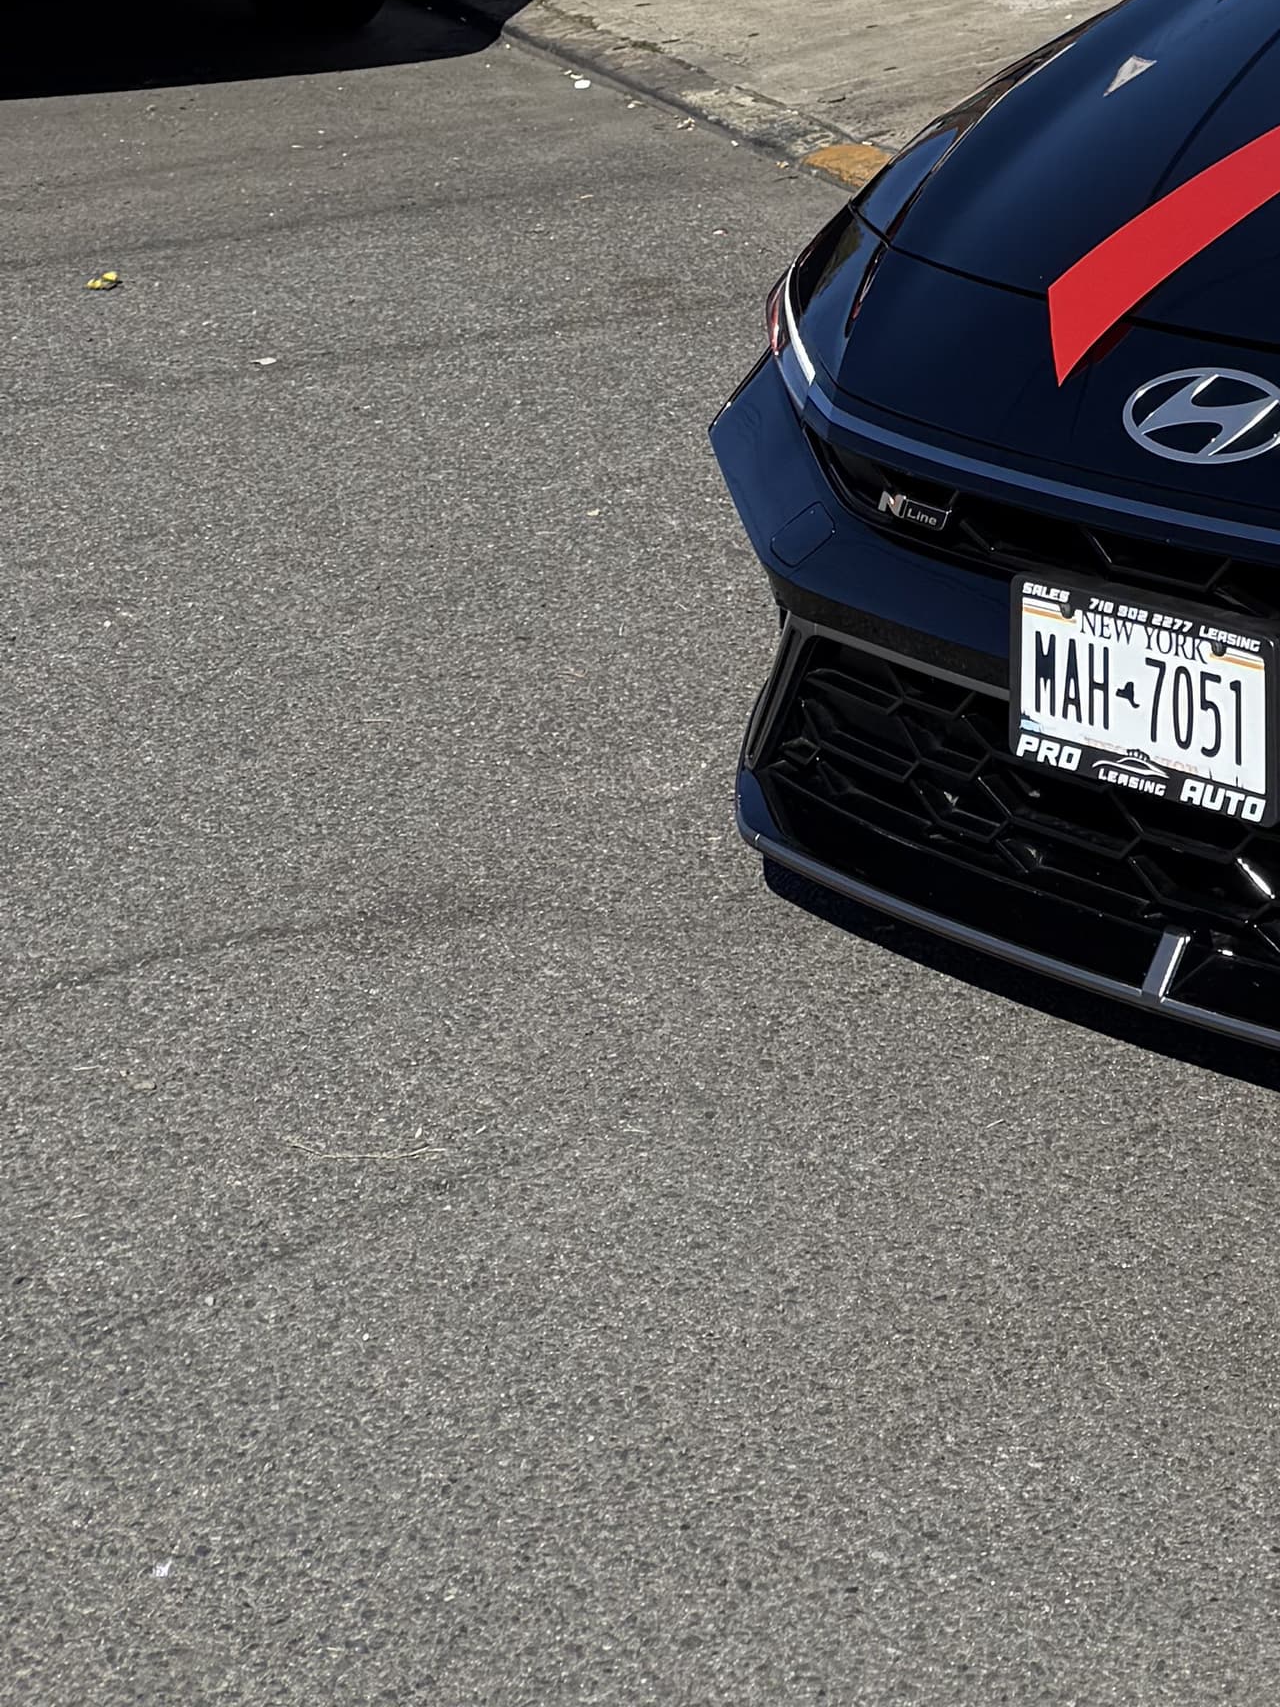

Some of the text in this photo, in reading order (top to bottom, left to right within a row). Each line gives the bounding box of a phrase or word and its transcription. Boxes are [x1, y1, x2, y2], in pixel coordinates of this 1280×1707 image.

[878, 491, 937, 525] N Line
[1023, 582, 1262, 652] SALES 718 902 2277 LEASING
[1080, 612, 1209, 664] NEW YORK
[1016, 734, 1082, 772] PRO
[1098, 769, 1167, 796] LEASING
[1180, 780, 1267, 823] AUTO
